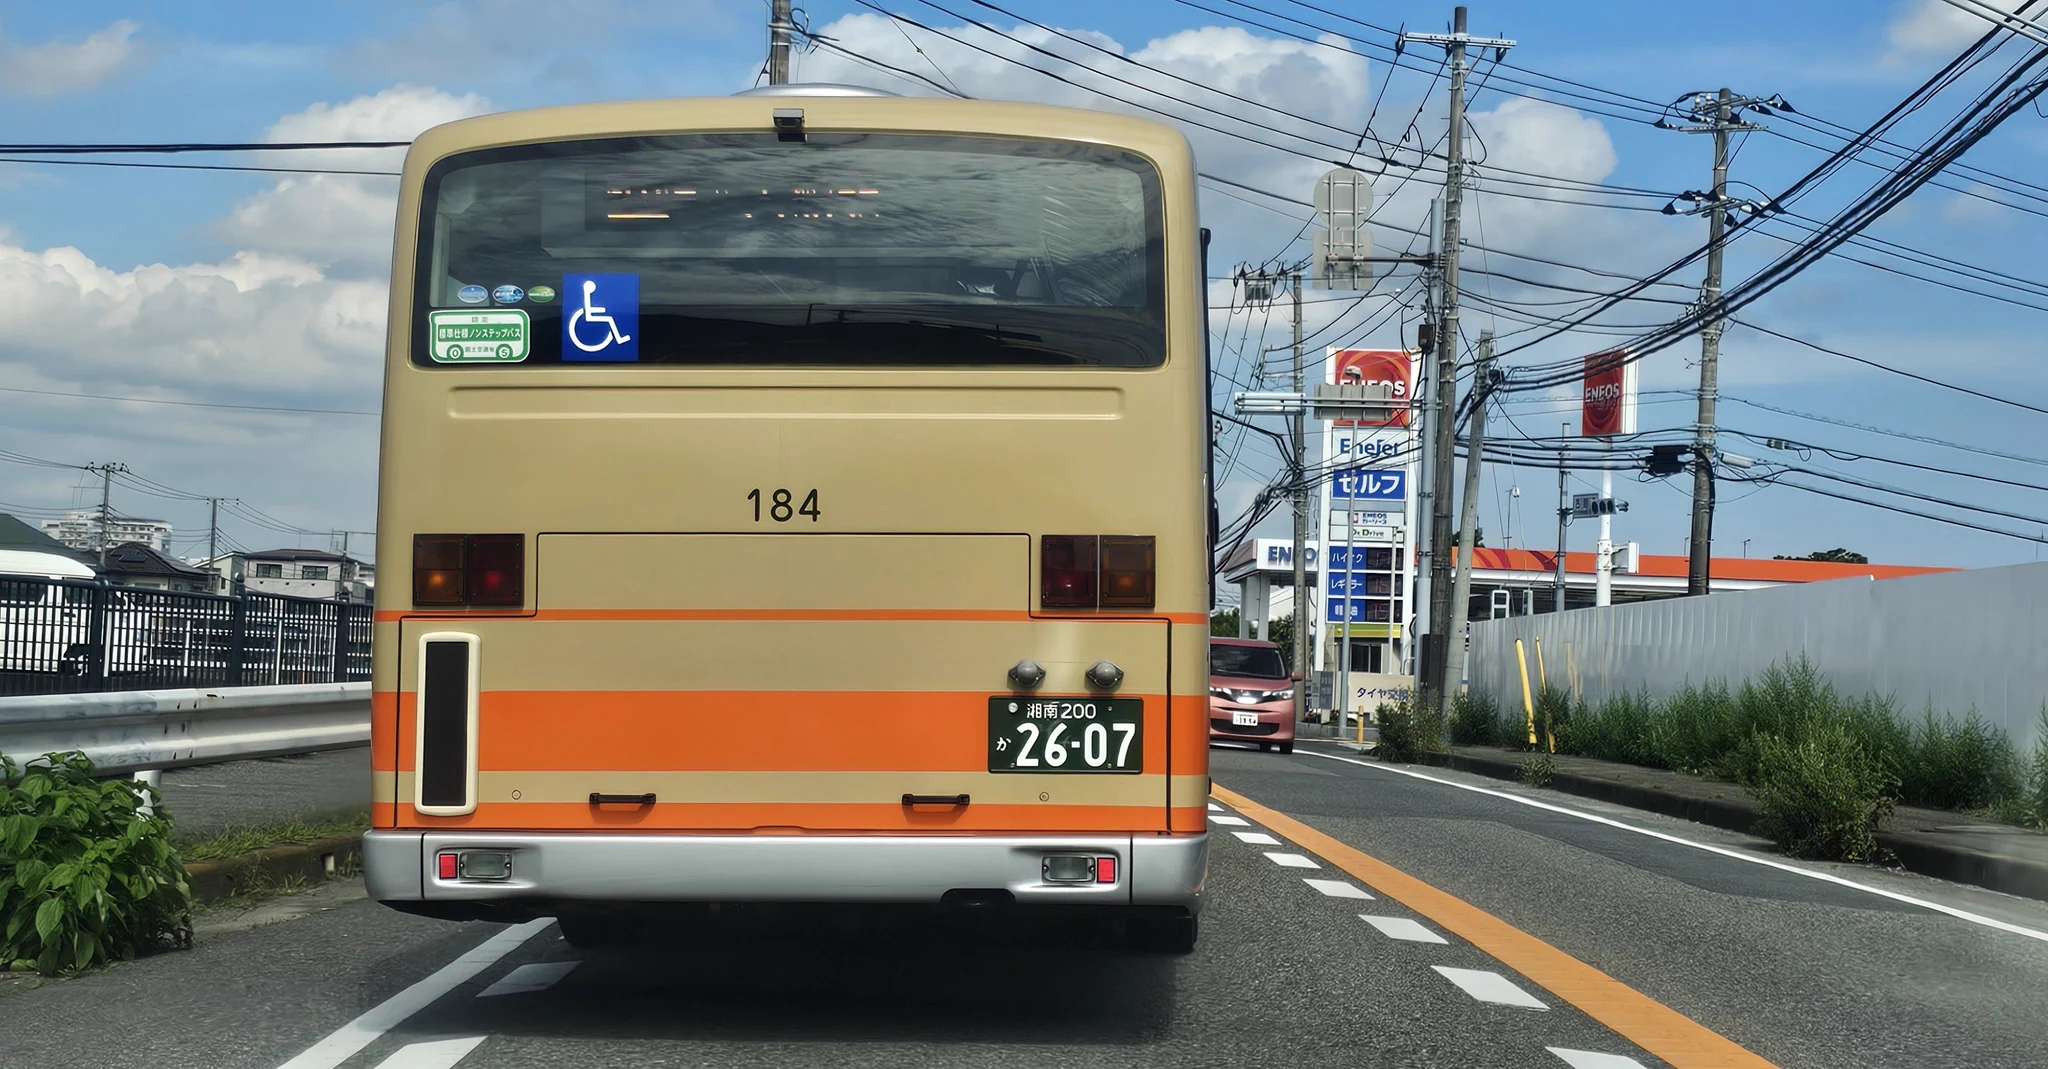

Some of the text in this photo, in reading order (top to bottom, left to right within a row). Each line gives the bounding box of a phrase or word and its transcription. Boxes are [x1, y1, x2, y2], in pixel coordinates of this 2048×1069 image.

[501, 349, 509, 357] 5
[1585, 383, 1619, 402] ENEOS
[1338, 473, 1400, 494] セルフ
[747, 488, 821, 522] 184
[1268, 546, 1318, 561] ENO
[1332, 552, 1363, 563] ハイク
[1331, 579, 1363, 590] レギラー
[1026, 702, 1097, 719] 湘南200
[996, 722, 1136, 767] か 26-07
